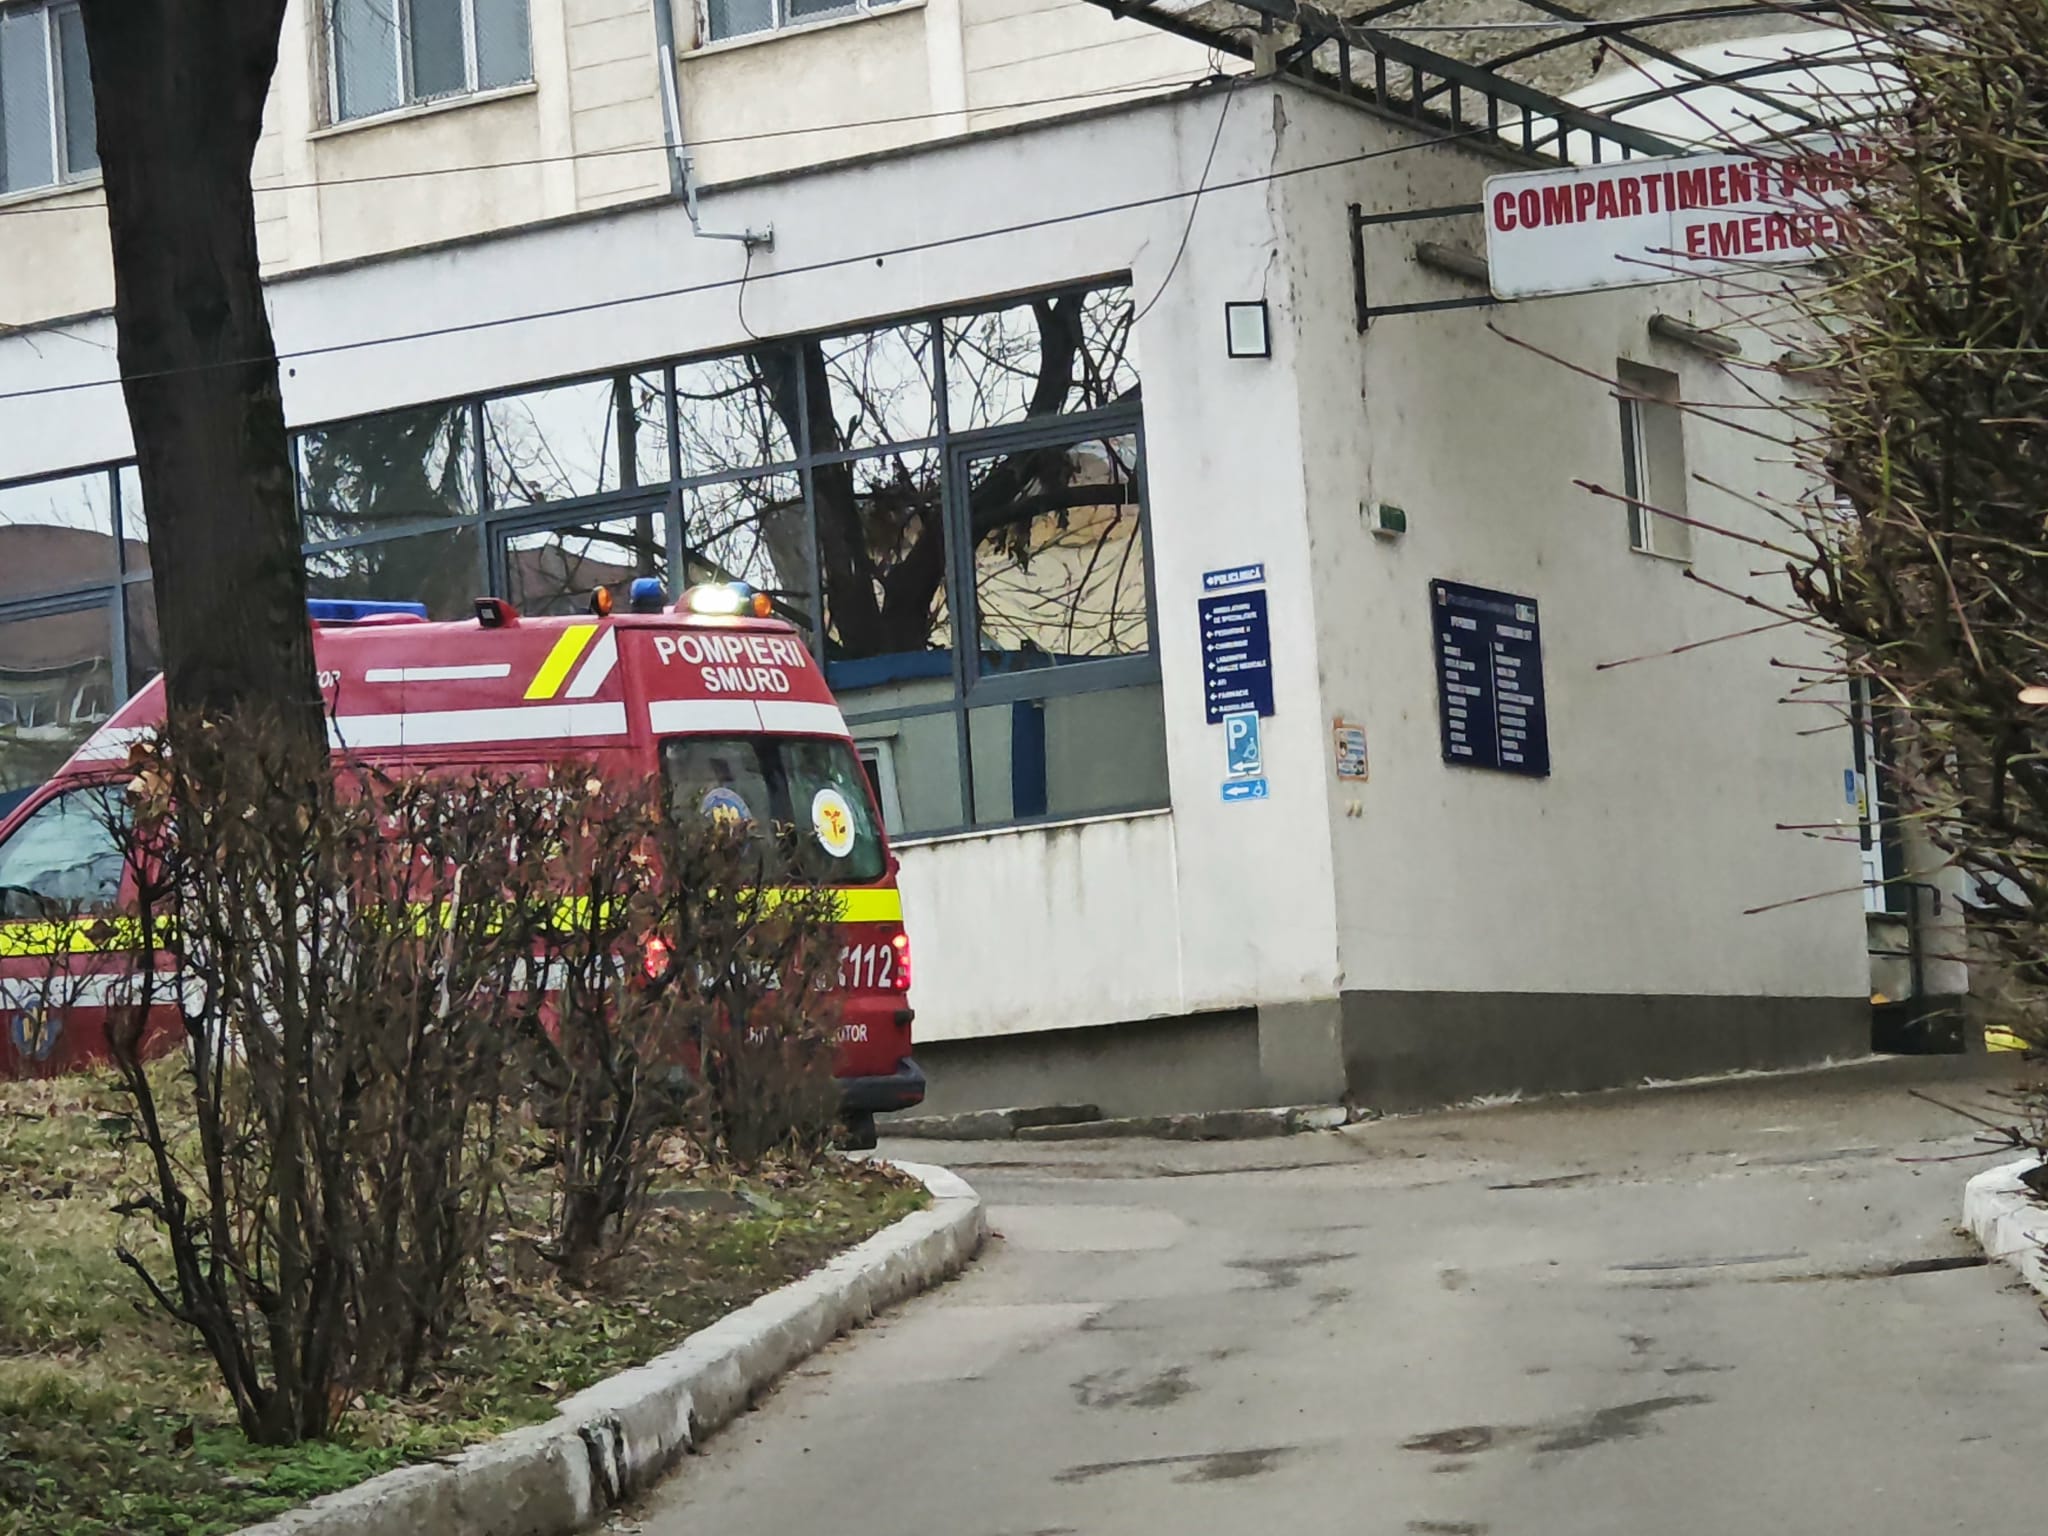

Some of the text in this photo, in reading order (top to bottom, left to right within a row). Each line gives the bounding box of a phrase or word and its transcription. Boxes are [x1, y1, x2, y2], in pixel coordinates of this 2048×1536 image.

[1493, 161, 1772, 232] COMPARTIMENT
[653, 635, 807, 669] POMPIERII
[700, 666, 790, 694] SMURD
[1229, 719, 1248, 750] P
